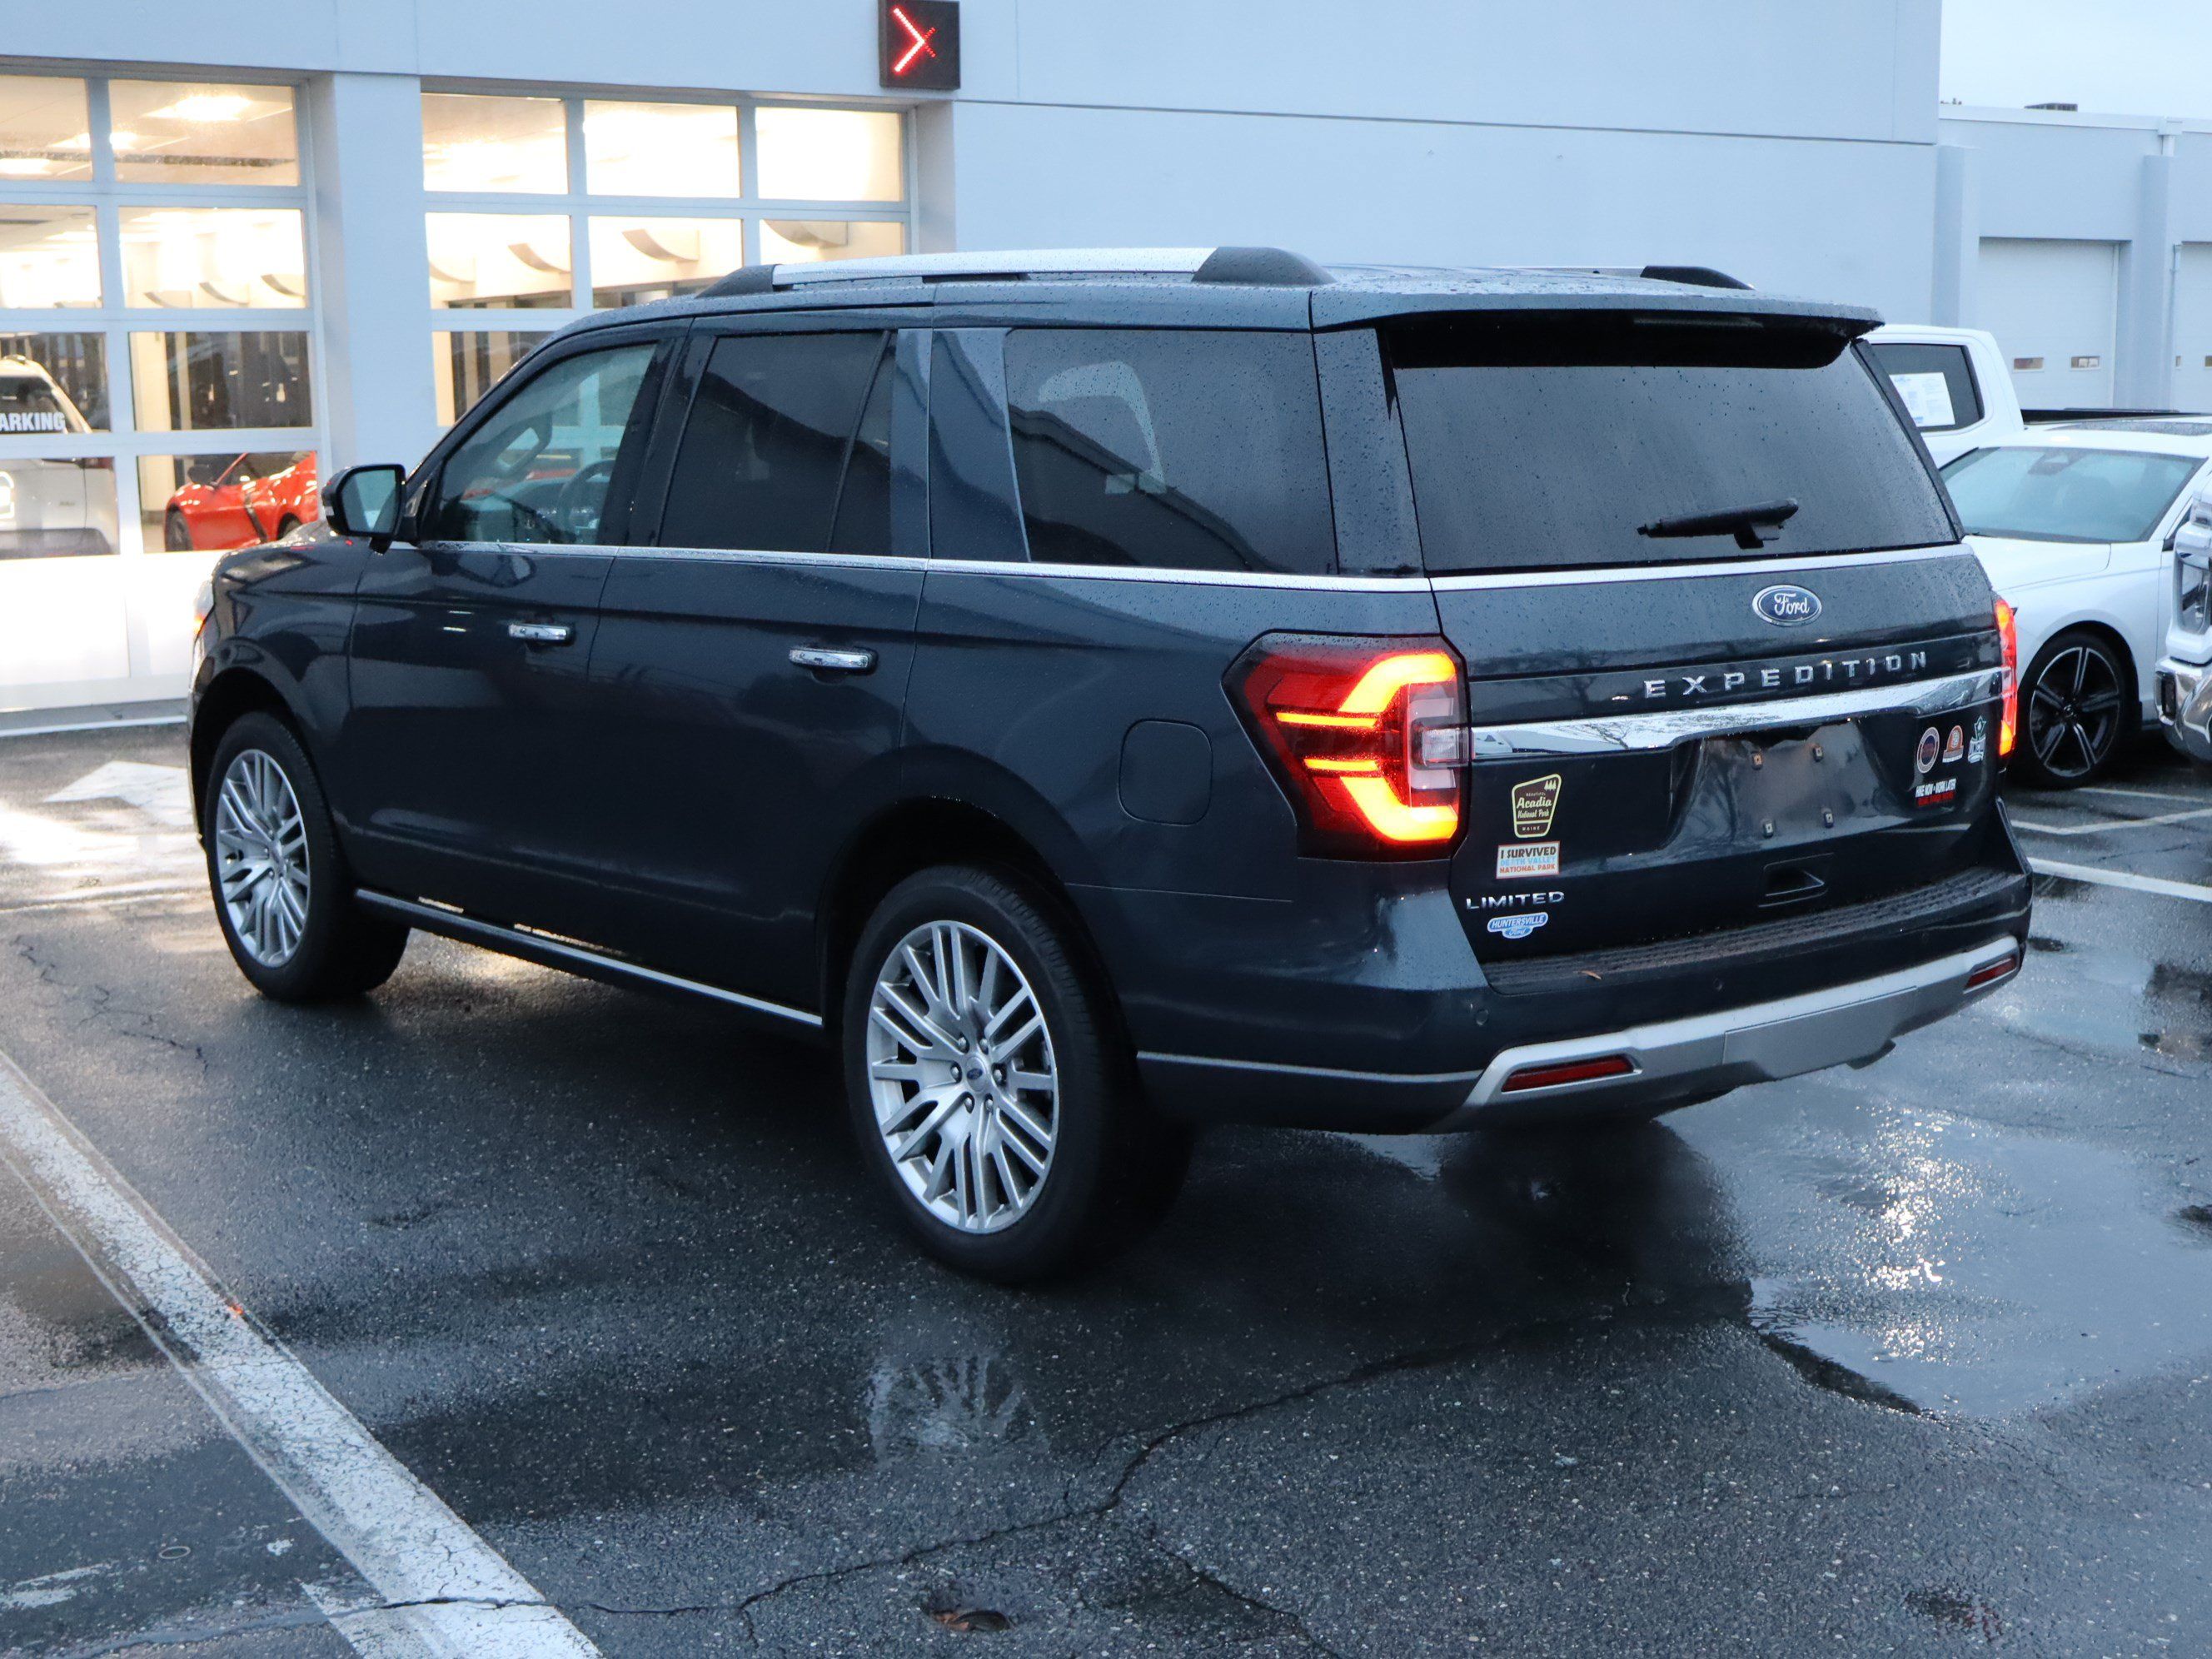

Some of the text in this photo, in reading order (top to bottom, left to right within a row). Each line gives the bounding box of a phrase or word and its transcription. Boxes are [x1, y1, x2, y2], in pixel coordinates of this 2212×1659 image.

[1774, 592, 1810, 616] Ford
[1644, 651, 1927, 699] EXPEDITION
[1517, 796, 1552, 809] Acadia
[1517, 808, 1550, 819] National Park
[1501, 846, 1557, 859] I SURVIVED
[1500, 865, 1536, 874] NATIONAL
[1466, 891, 1565, 909] LIMITED
[1492, 914, 1545, 929] HUNTERSVILLE
